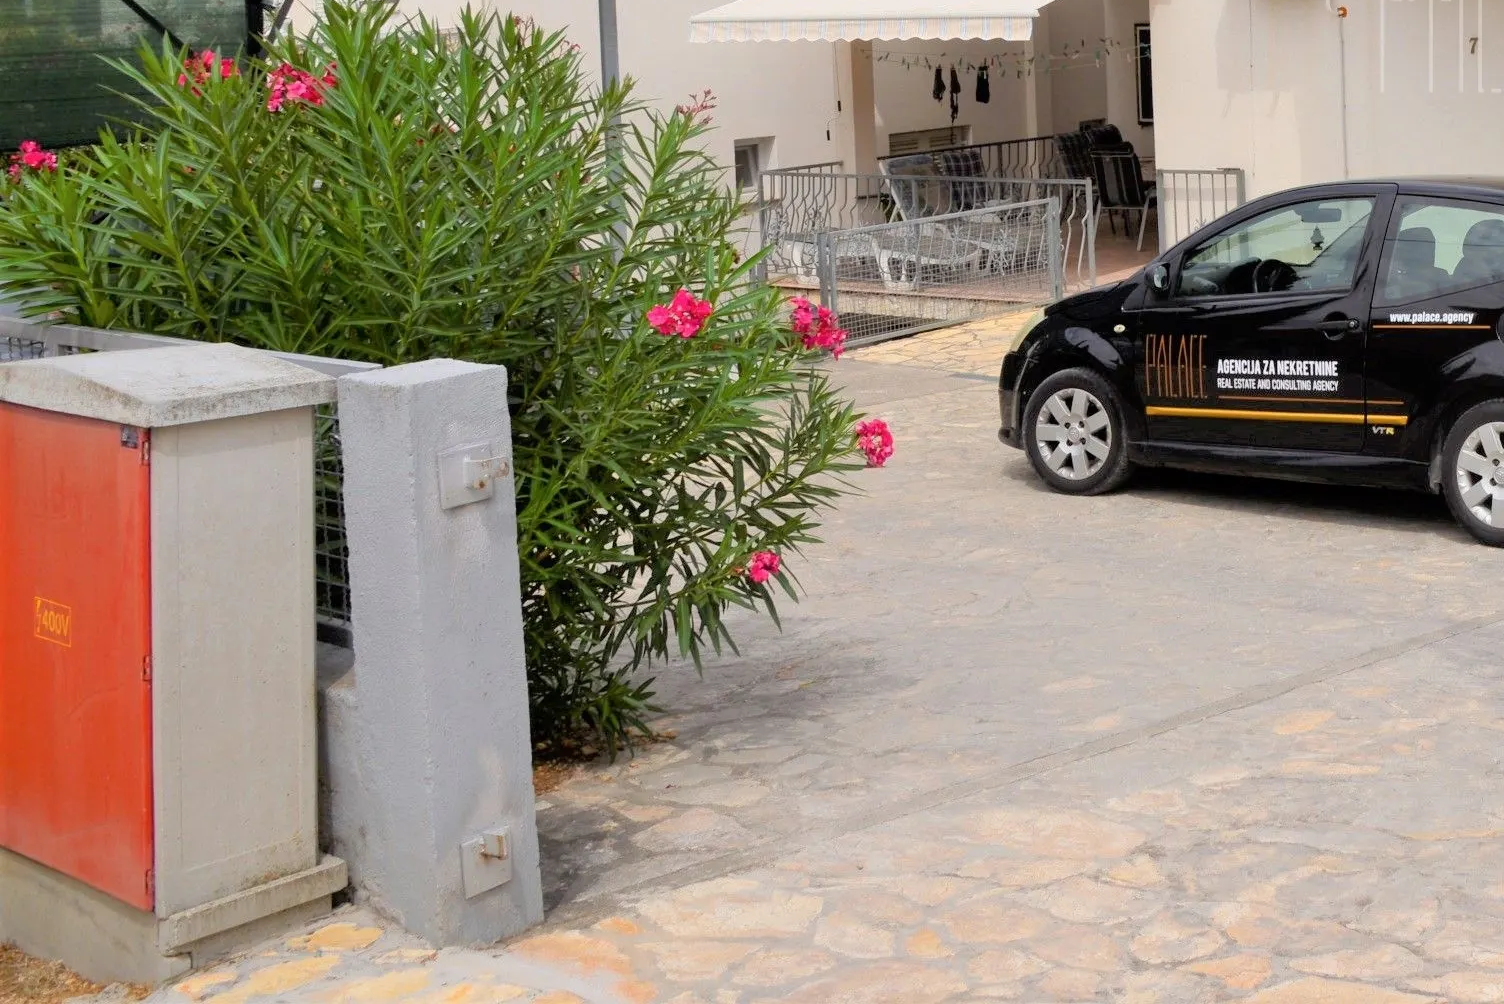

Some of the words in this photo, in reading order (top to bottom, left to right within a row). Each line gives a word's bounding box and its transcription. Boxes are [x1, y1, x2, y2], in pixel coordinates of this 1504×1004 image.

[1469, 37, 1479, 54] 7
[1389, 311, 1475, 325] www.palace.agency
[1145, 334, 1207, 398] PALACE
[1217, 359, 1261, 375] AGENCIJA
[1262, 360, 1275, 375] ZA
[1276, 360, 1338, 376] NEKRETNINE
[1217, 378, 1233, 389] REAL
[1233, 378, 1256, 390] ESTATE
[1257, 379, 1271, 390] AND
[1272, 379, 1311, 391] CONSULTING
[1312, 380, 1339, 392] AGENCY
[1372, 426, 1395, 436] VTR
[42, 610, 69, 637] 400V
